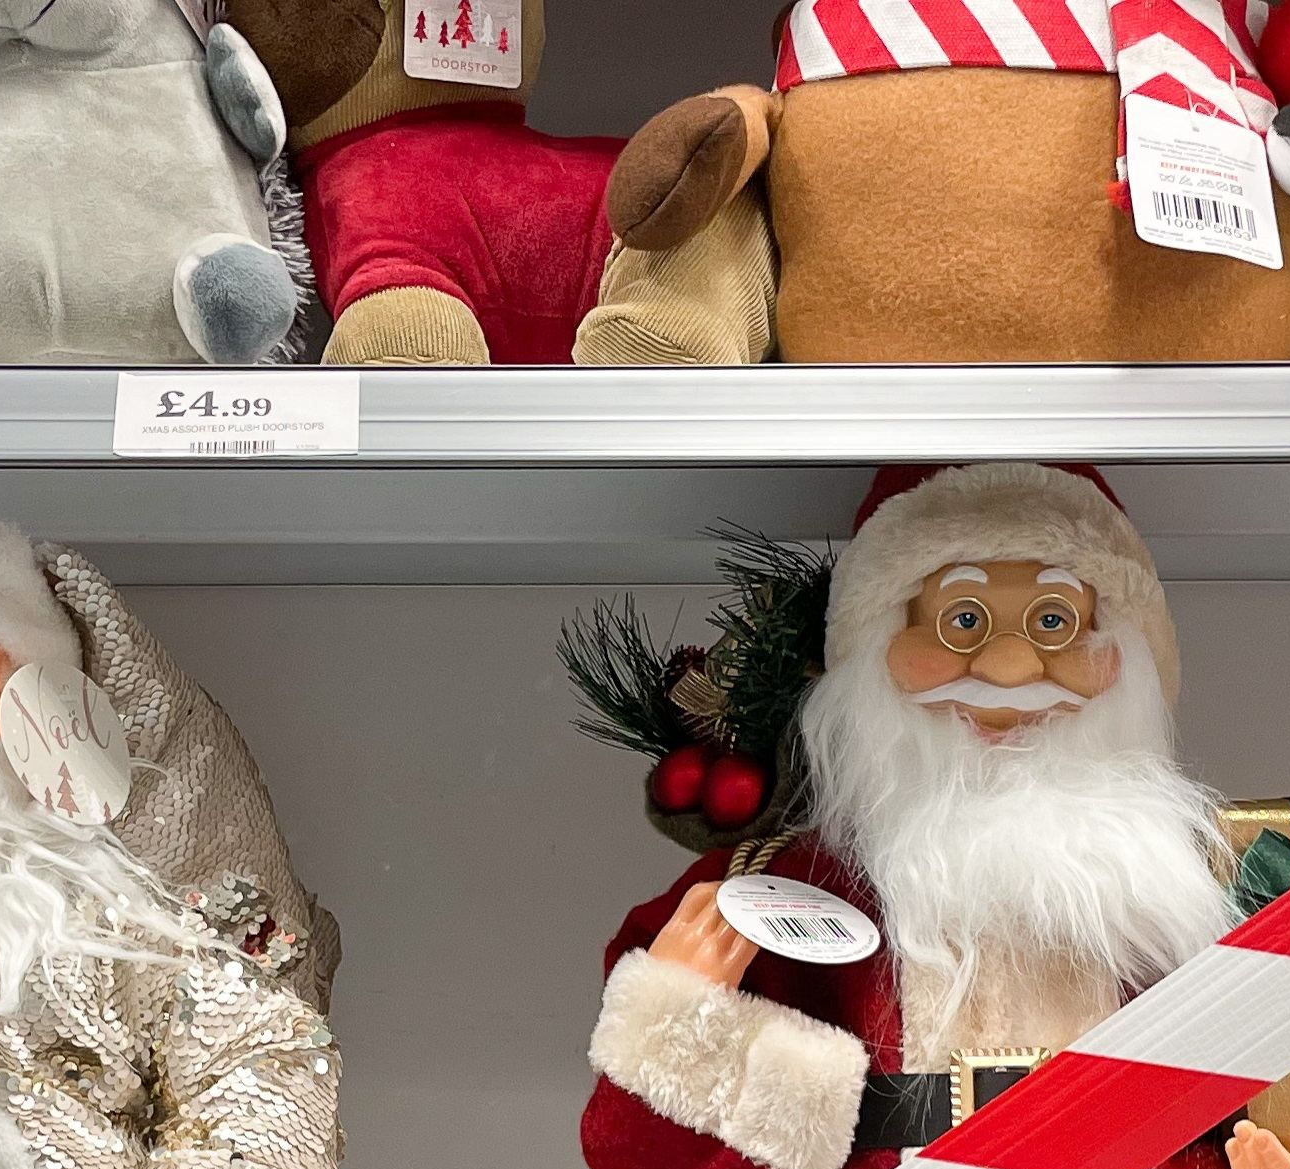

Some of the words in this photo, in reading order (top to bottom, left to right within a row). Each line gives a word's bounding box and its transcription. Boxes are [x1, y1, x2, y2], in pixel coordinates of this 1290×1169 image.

[432, 58, 498, 74] DOORSTOP
[156, 390, 272, 418] £4.99
[142, 424, 170, 434] XMAS
[172, 424, 225, 433] ASSORTED
[228, 423, 259, 432] PLUSH
[263, 422, 325, 432] DOORSTOPS
[9, 665, 111, 764] Noël
